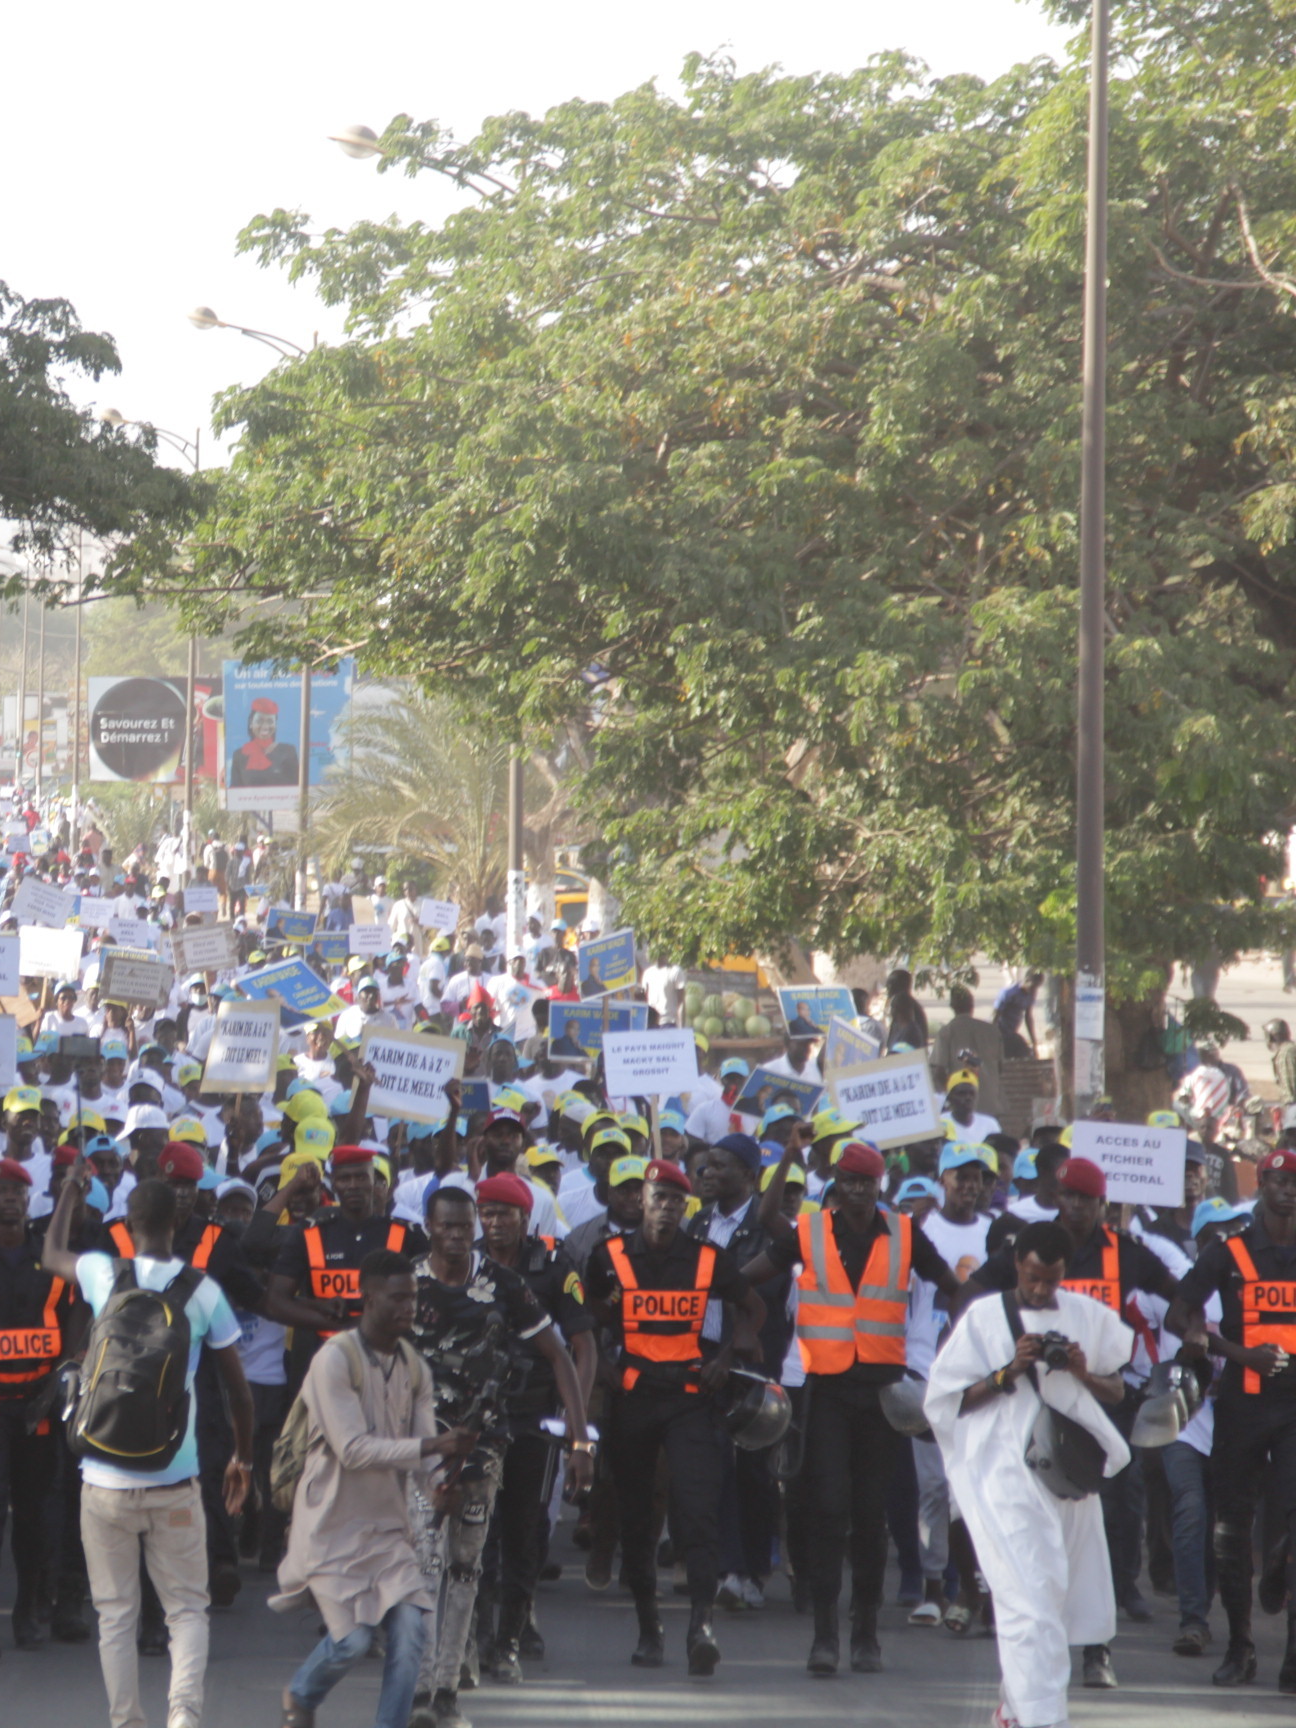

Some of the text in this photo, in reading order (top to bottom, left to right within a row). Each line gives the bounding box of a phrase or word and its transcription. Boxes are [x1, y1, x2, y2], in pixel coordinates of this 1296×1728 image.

[100, 717, 175, 730] Savourez Et
[100, 731, 161, 743] Démarrez
[592, 1010, 620, 1021] WDE
[405, 1052, 419, 1070] DE
[419, 1056, 427, 1071] A
[622, 1055, 677, 1065] MACKY SALL
[632, 1067, 670, 1077] GROSSIT
[397, 1077, 410, 1093] LE
[410, 1080, 435, 1099] MEEL
[880, 1107, 895, 1122] LE
[894, 1102, 919, 1120] MEEL
[1096, 1135, 1162, 1148] ACCES AU
[1101, 1154, 1154, 1167] FICHIER
[1105, 1173, 1165, 1186] ECTORAL
[321, 1274, 357, 1294] POL
[632, 1294, 700, 1317] POLICE
